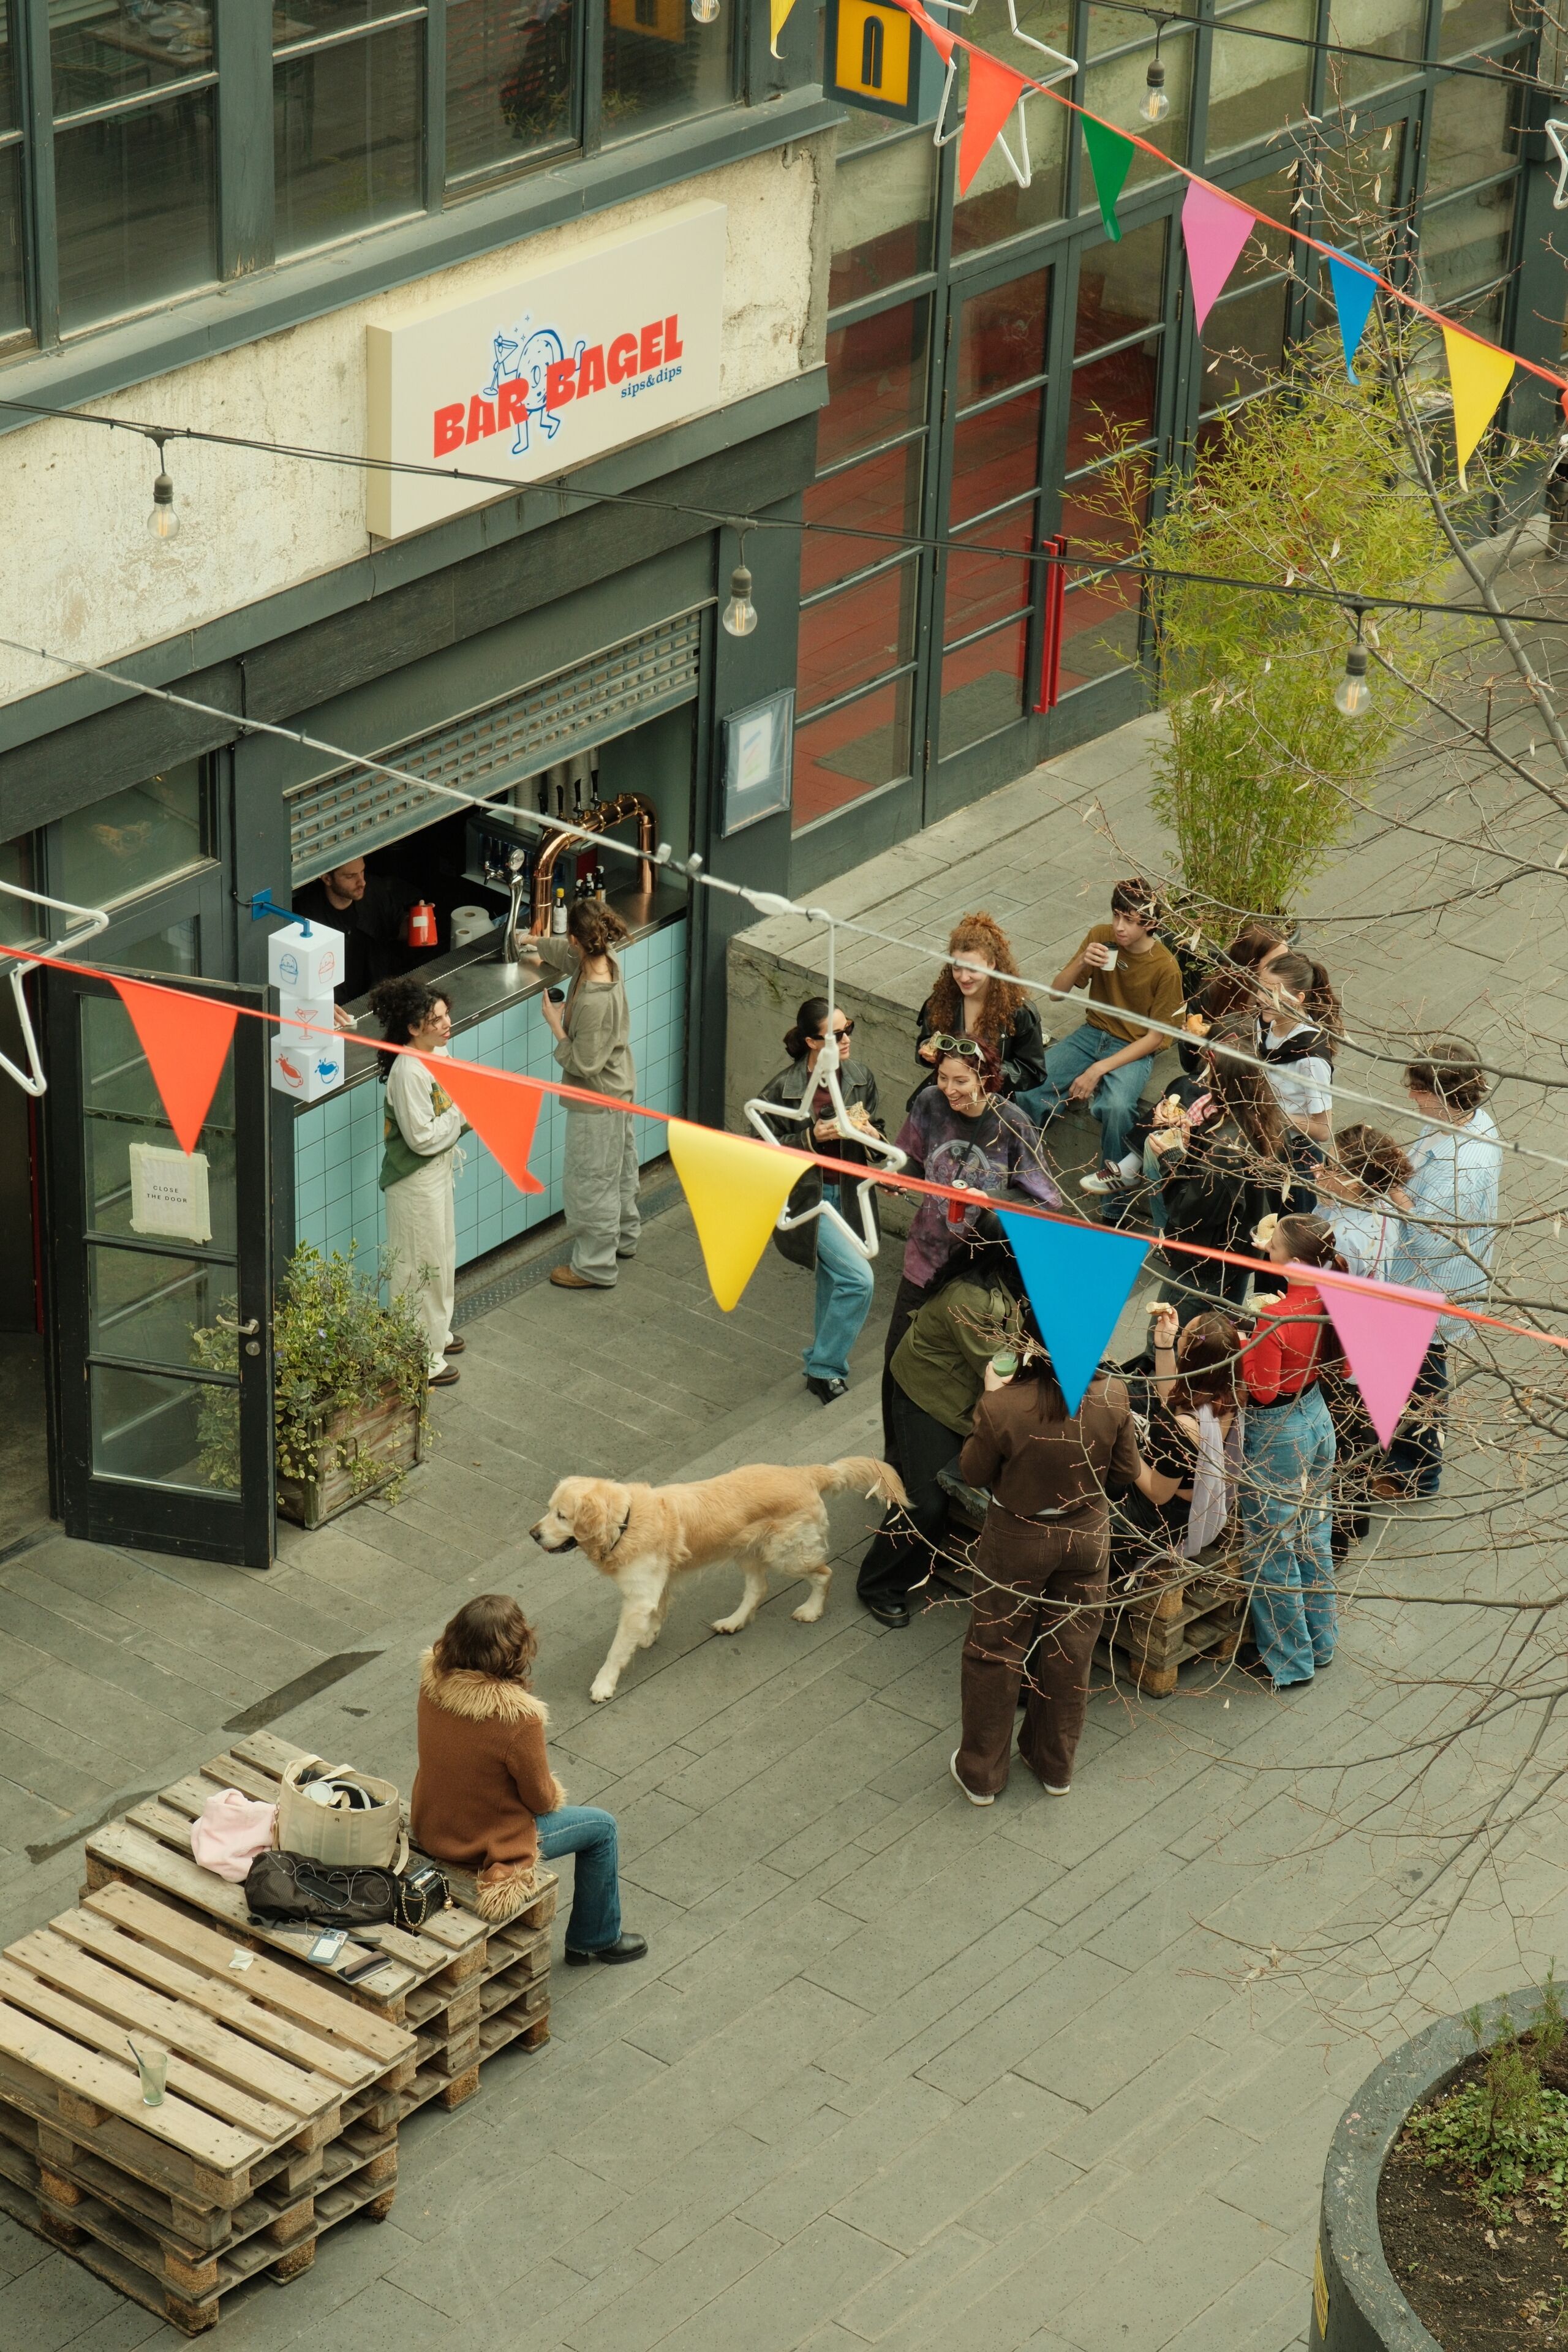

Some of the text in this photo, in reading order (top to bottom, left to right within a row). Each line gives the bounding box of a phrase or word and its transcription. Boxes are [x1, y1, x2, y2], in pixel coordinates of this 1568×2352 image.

[434, 314, 684, 458] BAR BAGEL
[620, 366, 682, 398] sips&dips
